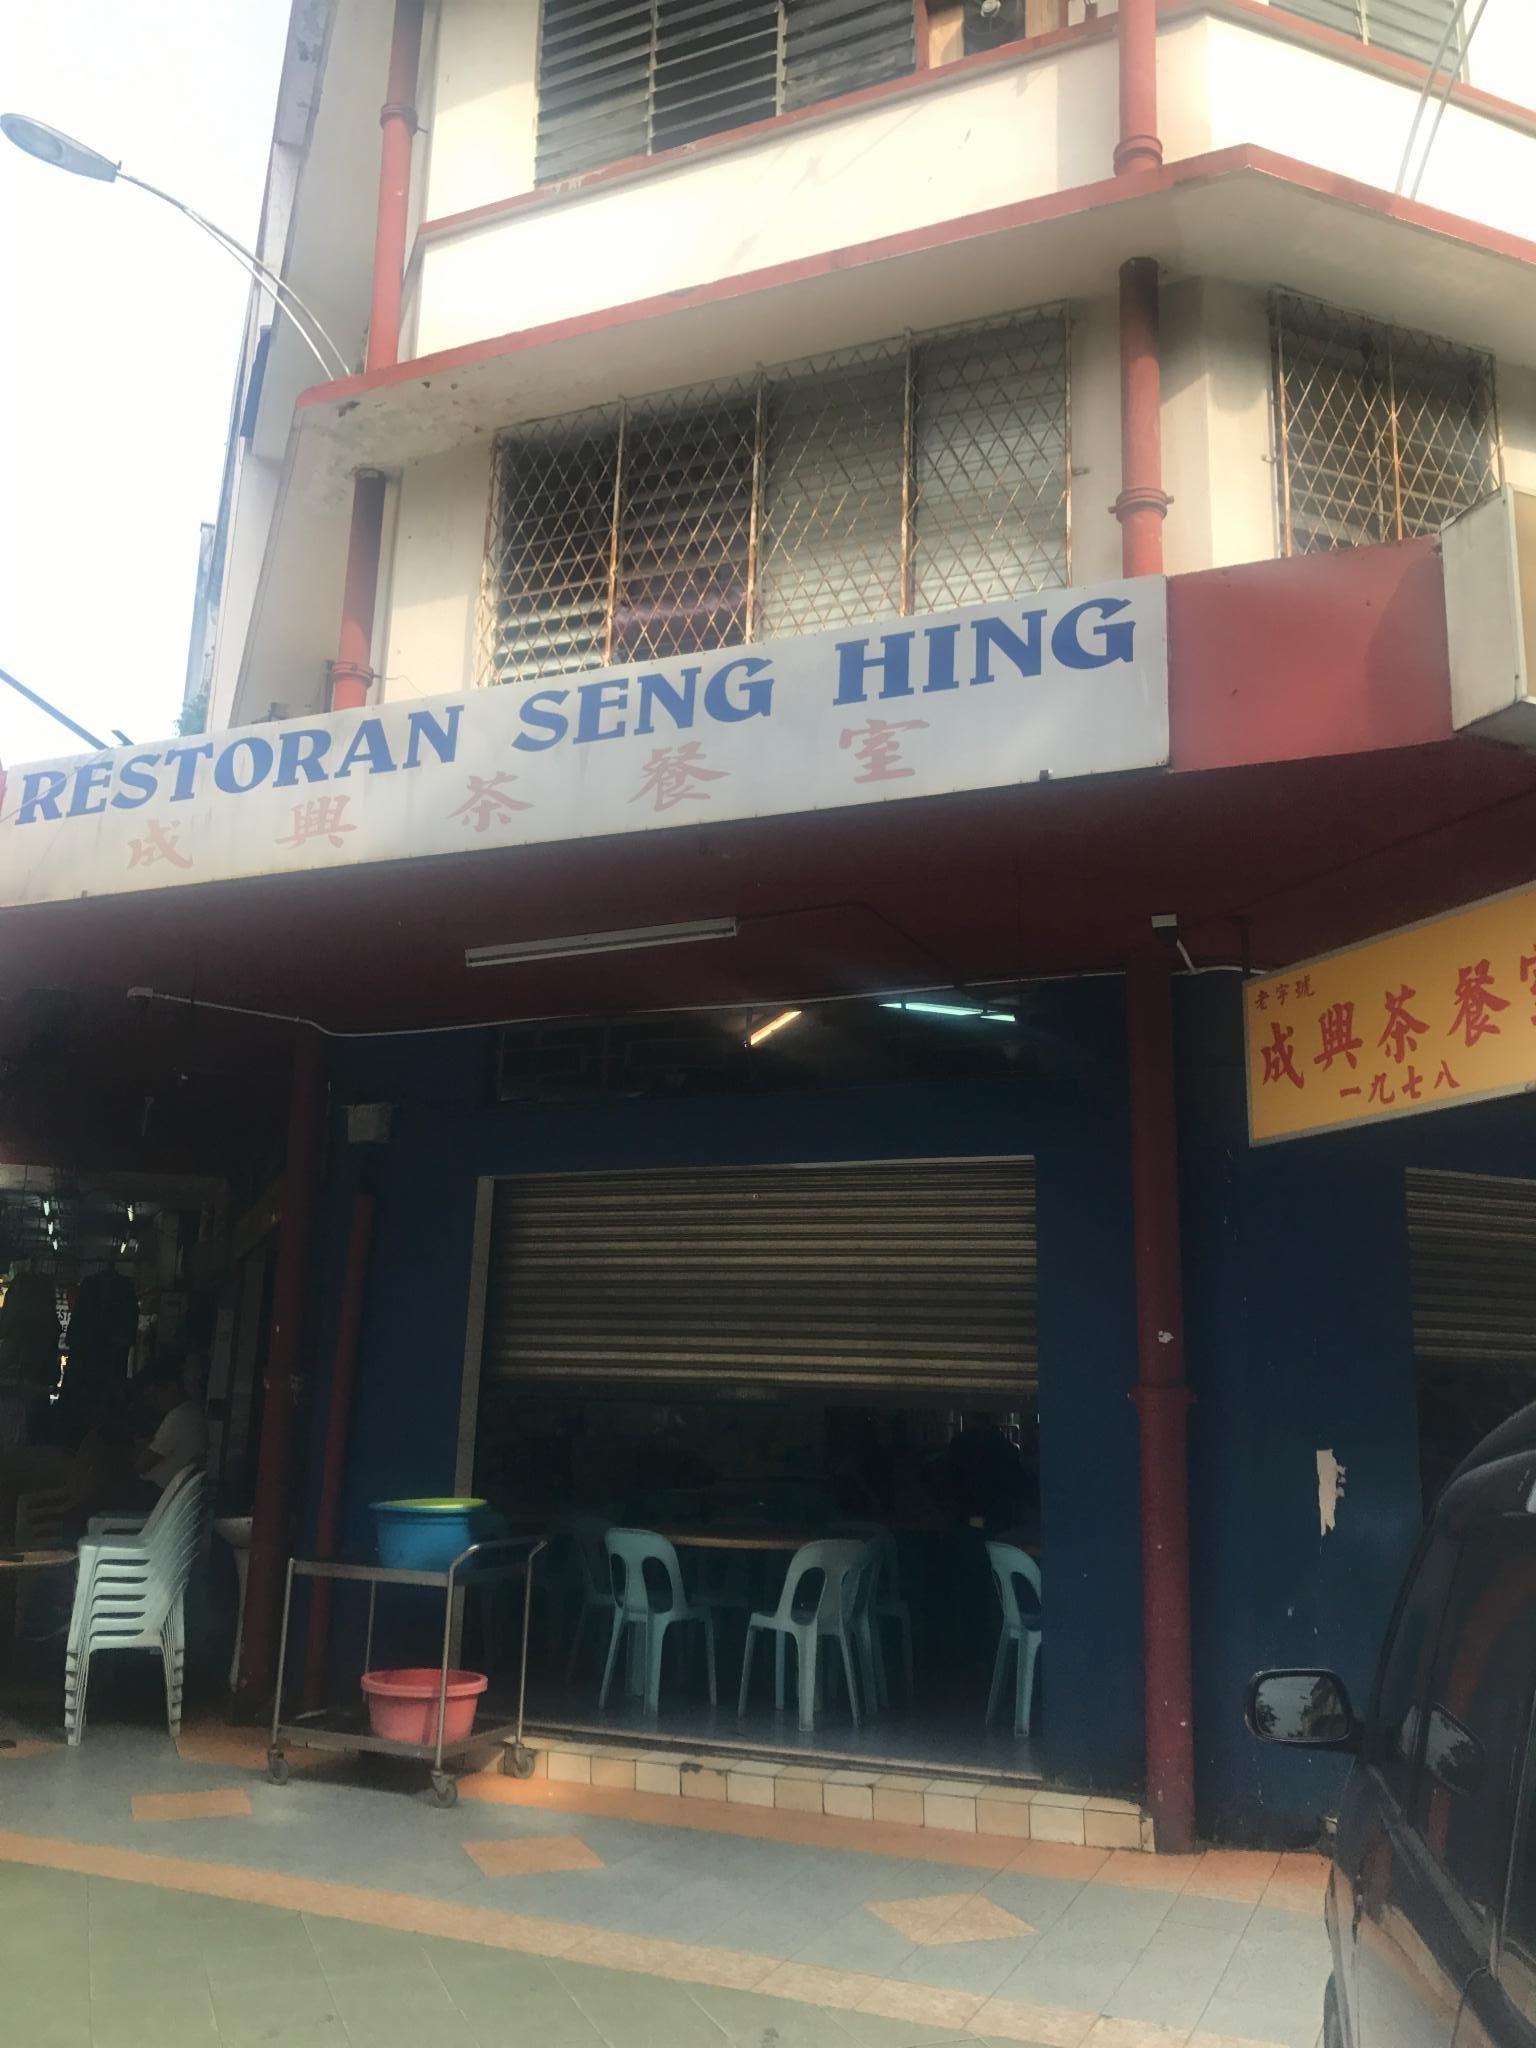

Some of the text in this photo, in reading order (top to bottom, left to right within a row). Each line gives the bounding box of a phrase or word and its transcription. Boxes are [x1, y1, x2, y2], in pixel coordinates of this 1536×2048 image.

[15, 598, 1135, 825] RESTORAN SENG HING
[127, 719, 929, 870] 成興茶餐室
[1339, 1060, 1460, 1104] 一九七八
